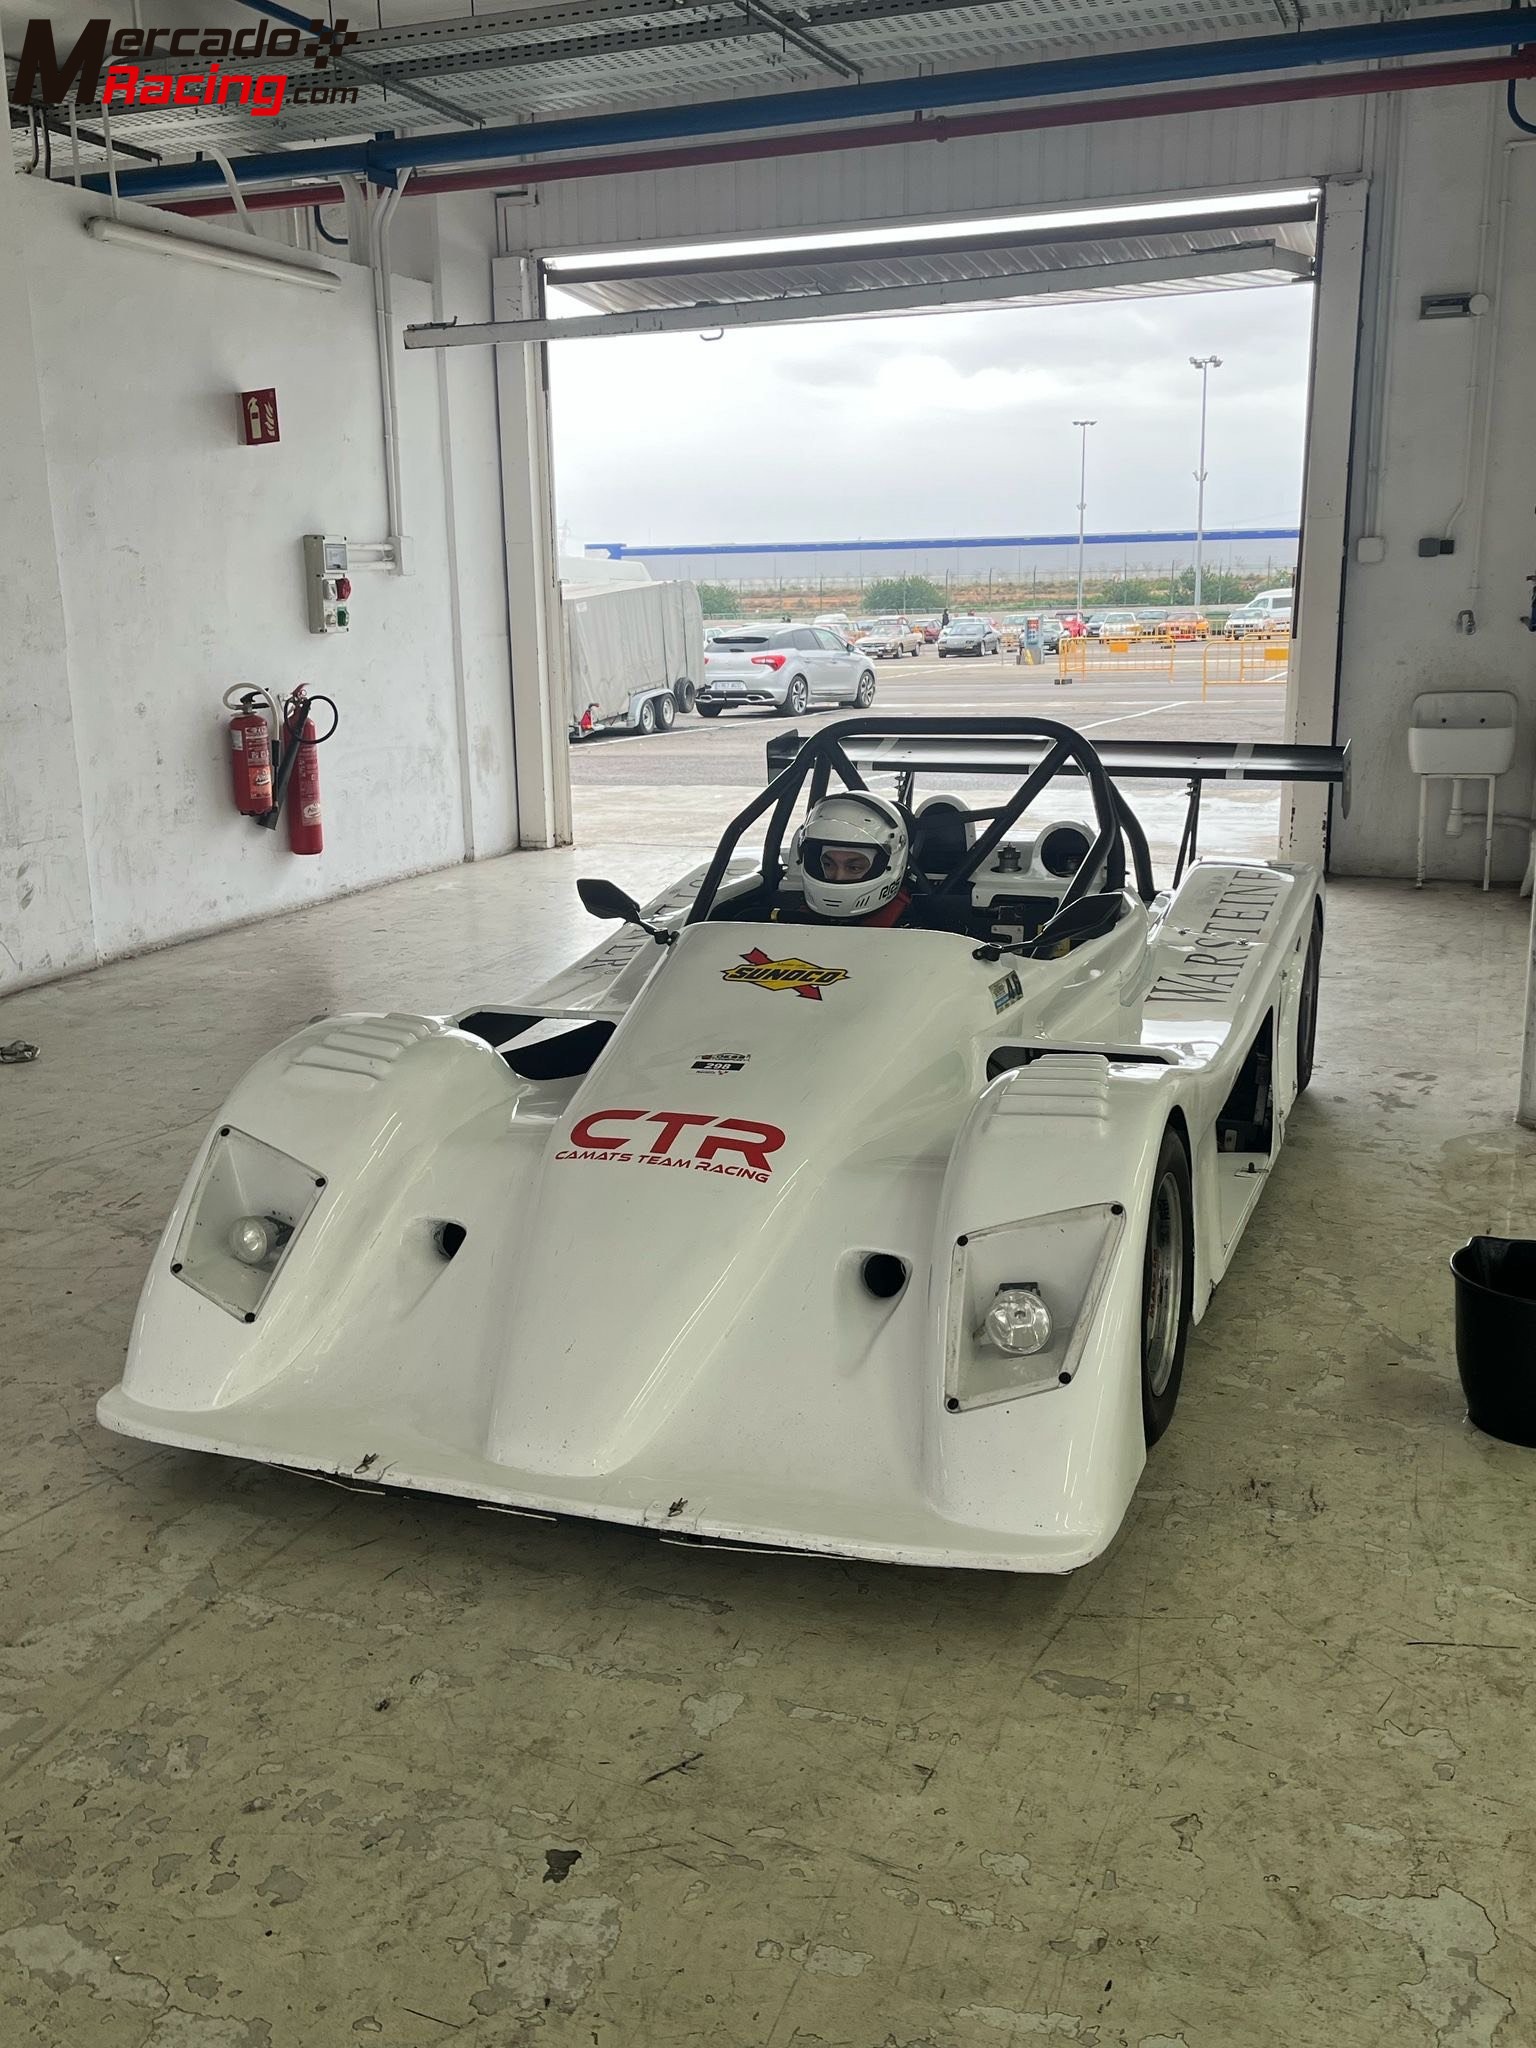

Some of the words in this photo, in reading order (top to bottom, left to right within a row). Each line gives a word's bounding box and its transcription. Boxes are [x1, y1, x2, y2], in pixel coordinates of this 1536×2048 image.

[728, 967, 843, 983] SUNOCO
[570, 1109, 786, 1172] CTR
[555, 1150, 632, 1162] CAMATS
[638, 1154, 691, 1168] TEAM
[694, 1161, 771, 1184] RACING
